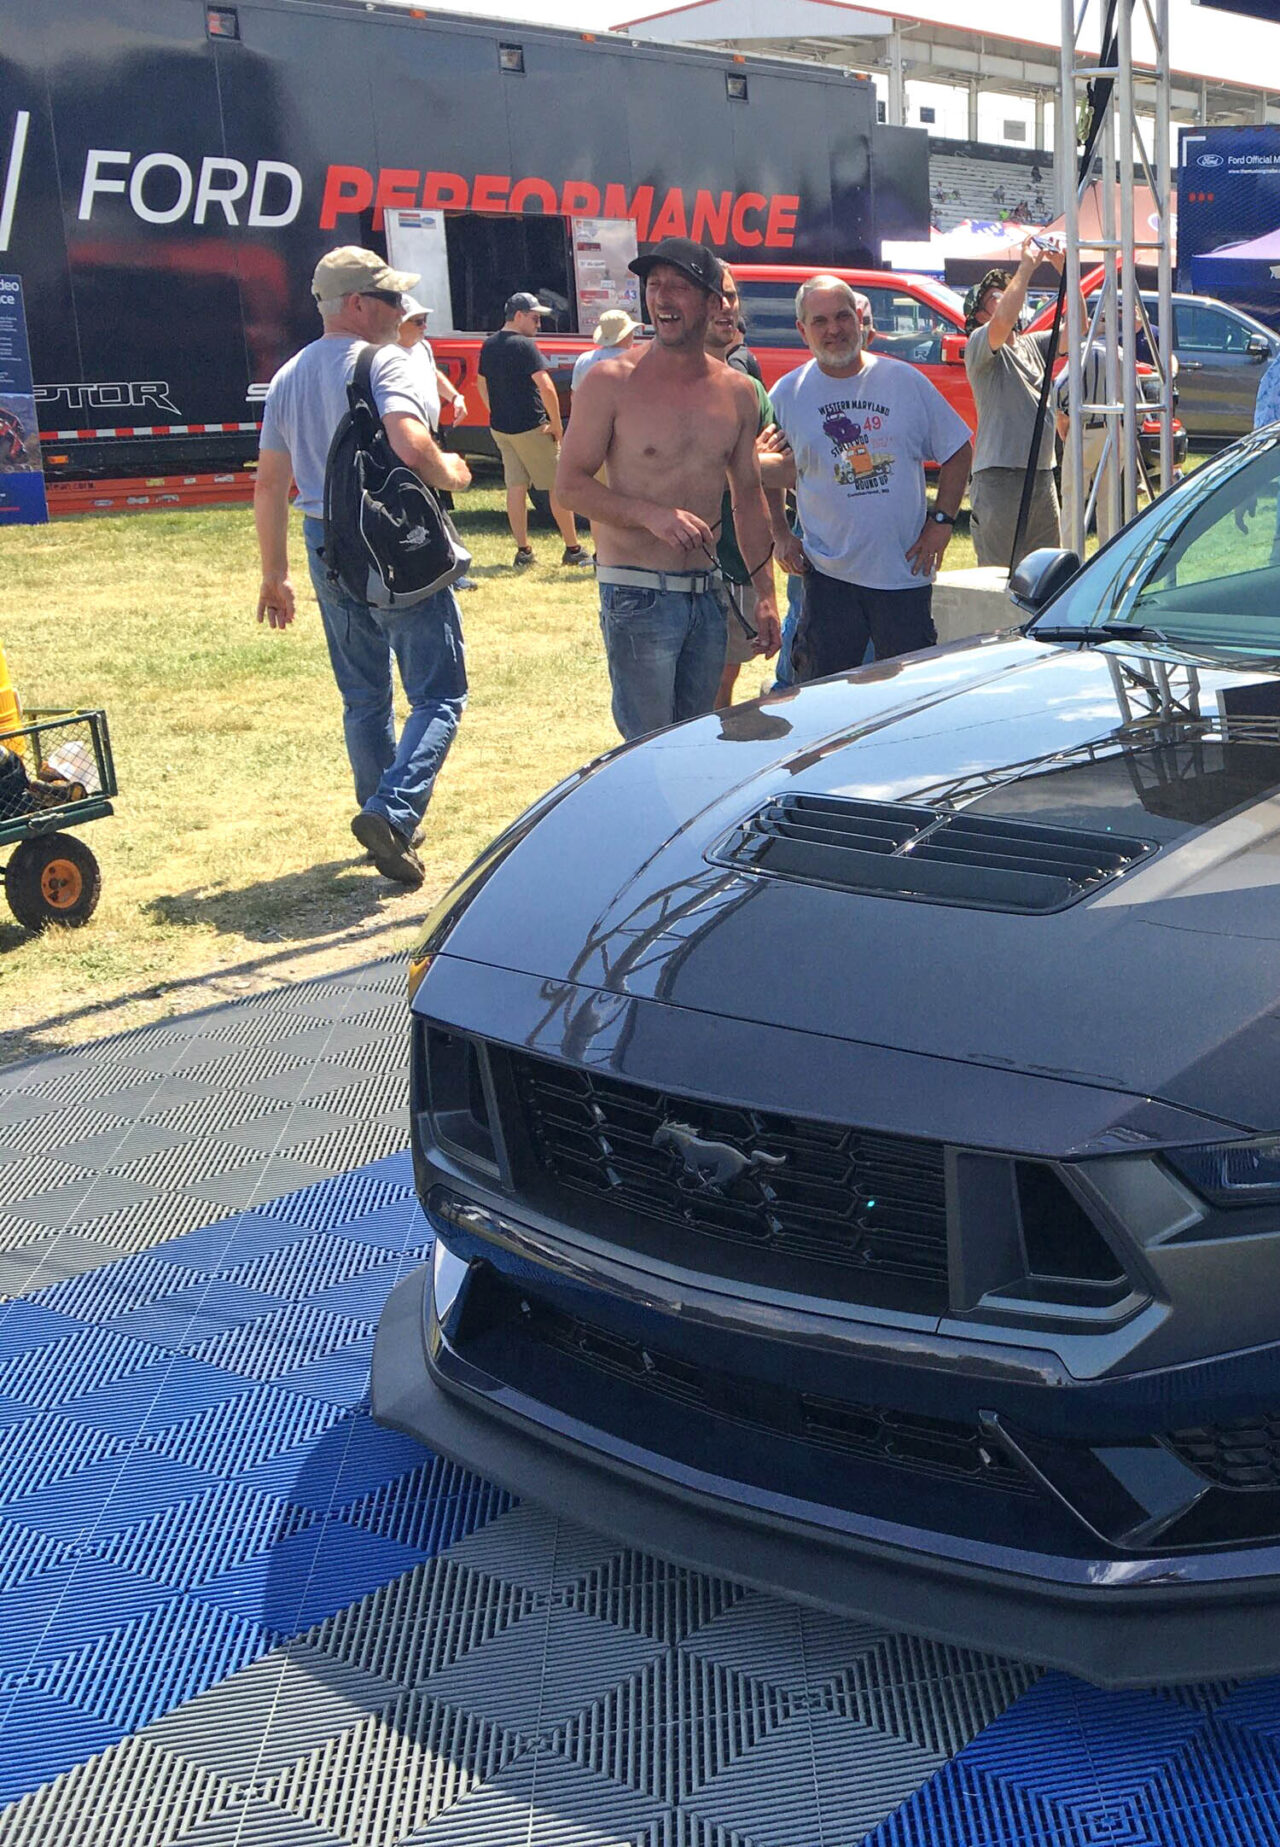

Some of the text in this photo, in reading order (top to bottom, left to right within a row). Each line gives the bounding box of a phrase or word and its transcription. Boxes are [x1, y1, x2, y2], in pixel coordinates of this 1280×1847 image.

[1228, 156, 1245, 165] Ford
[1245, 155, 1272, 165] Official
[78, 149, 799, 248] FORD PERFORMANCE
[818, 400, 890, 416] WESTERN MARYLAND
[863, 415, 882, 431] 49
[855, 478, 879, 491] ROUND
